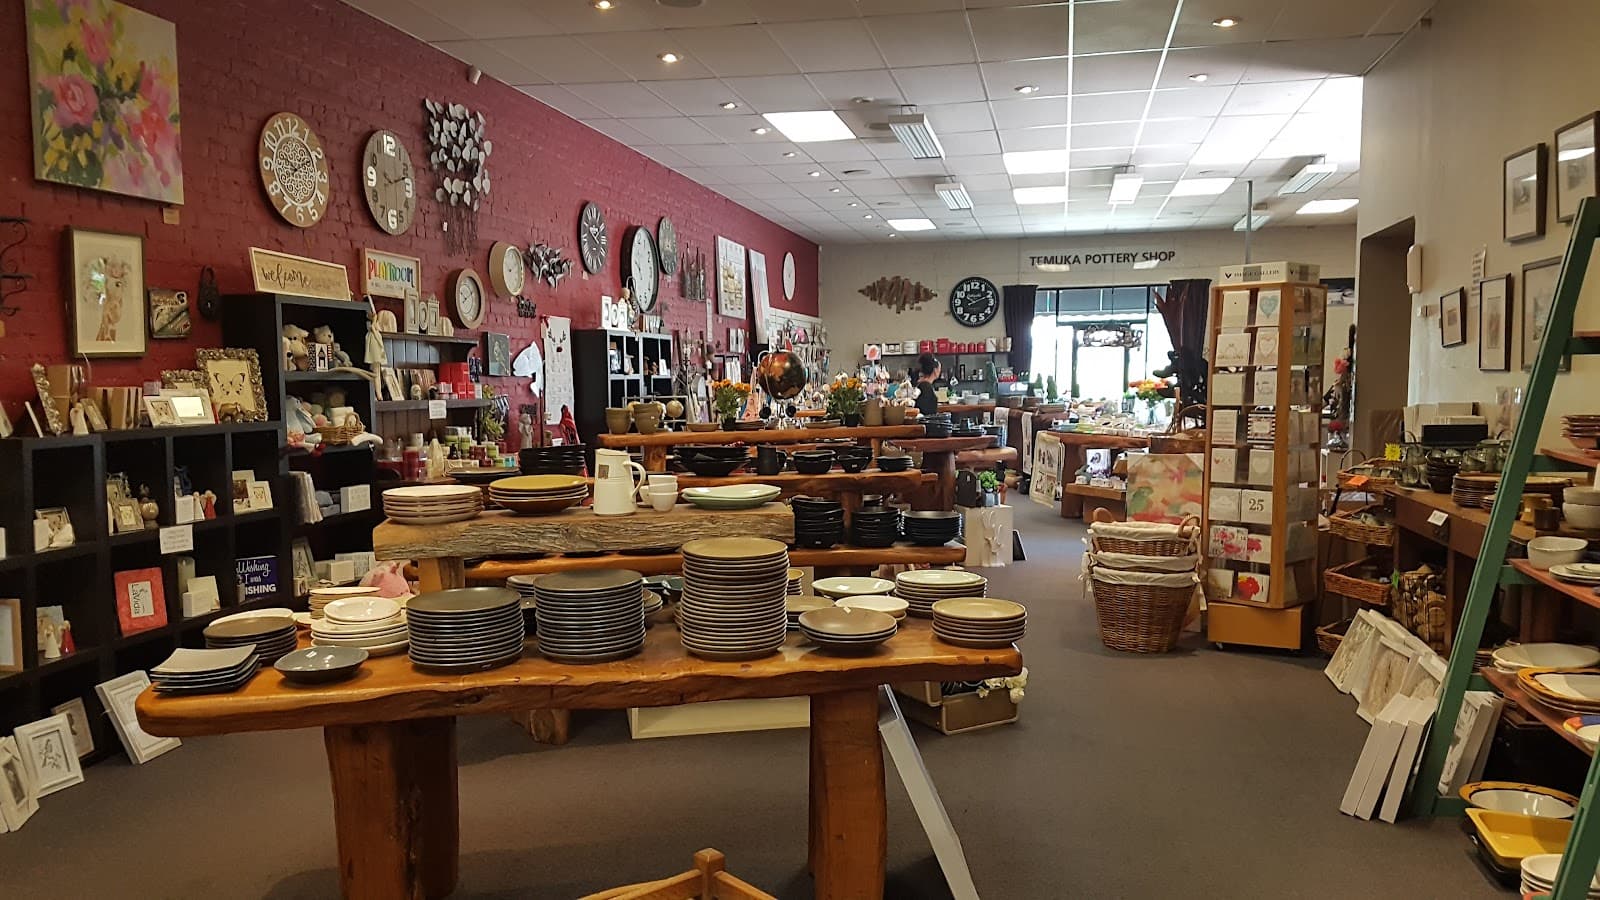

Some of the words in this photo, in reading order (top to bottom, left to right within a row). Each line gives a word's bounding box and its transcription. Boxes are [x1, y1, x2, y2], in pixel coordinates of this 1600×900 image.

[274, 117, 286, 138] 11
[286, 118, 299, 136] 12
[304, 127, 310, 143] 1
[264, 131, 277, 152] 10
[383, 134, 396, 157] 12
[311, 147, 323, 162] 2
[263, 156, 274, 171] 9
[317, 170, 328, 183] 3
[367, 166, 377, 187] 9
[269, 181, 280, 196] 8
[372, 189, 378, 203] 8
[405, 178, 413, 198] 3
[281, 196, 292, 213] 7
[316, 190, 325, 205] 4
[296, 205, 304, 222] 6
[307, 201, 318, 221] 5
[379, 205, 386, 219] 7
[398, 209, 405, 223] 5
[387, 211, 398, 230] 6
[1029, 254, 1081, 266] TEMUKA
[1085, 252, 1138, 265] POTTERY
[1142, 250, 1176, 263] SHOP
[261, 263, 311, 289] welcome
[367, 257, 415, 288] PLAYROOM
[963, 283, 970, 291] 11
[970, 282, 980, 290] 12
[1248, 498, 1265, 512] 25
[235, 559, 271, 576] Wishing
[244, 573, 250, 585] I
[245, 584, 276, 595] ISHING
